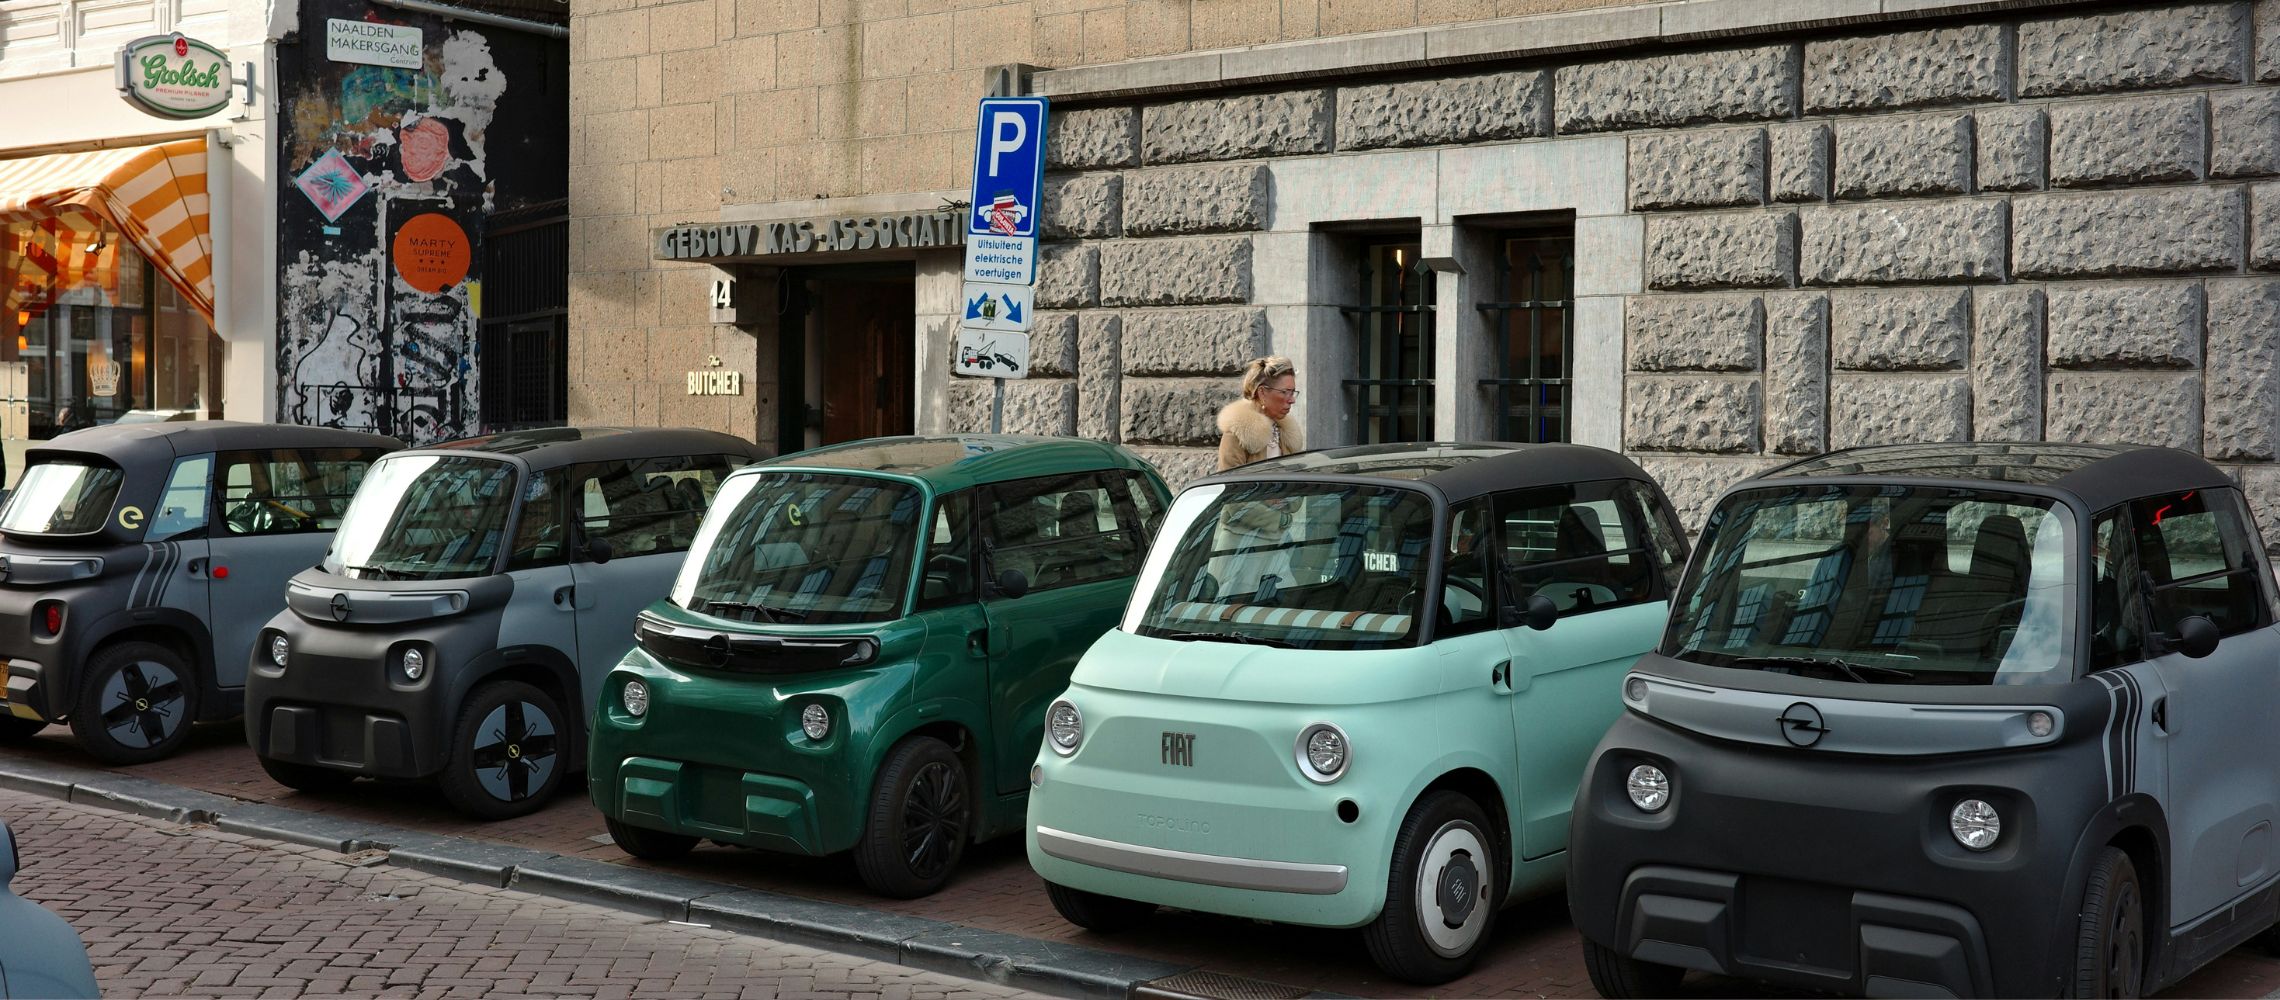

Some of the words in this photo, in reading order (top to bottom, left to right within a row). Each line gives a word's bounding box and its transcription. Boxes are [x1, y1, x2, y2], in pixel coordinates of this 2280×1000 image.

[331, 22, 394, 38] NAALDEN
[331, 37, 419, 57] MAKERSGANG
[390, 56, 420, 66] Centrum
[140, 54, 221, 89] Grolsch
[155, 87, 183, 95] PREMIUM
[184, 89, 210, 97] PILSNER
[989, 111, 1027, 177] P
[409, 237, 456, 249] MARTY
[660, 223, 757, 259] GEBOUW
[977, 240, 1023, 251] Uitsluitend
[413, 248, 452, 258] SUPREME
[975, 253, 1023, 265] elektrische
[974, 268, 1022, 280] voertuigen
[710, 280, 731, 307] 14
[687, 371, 740, 396] BUTCHER
[1161, 731, 1197, 768] FIAT
